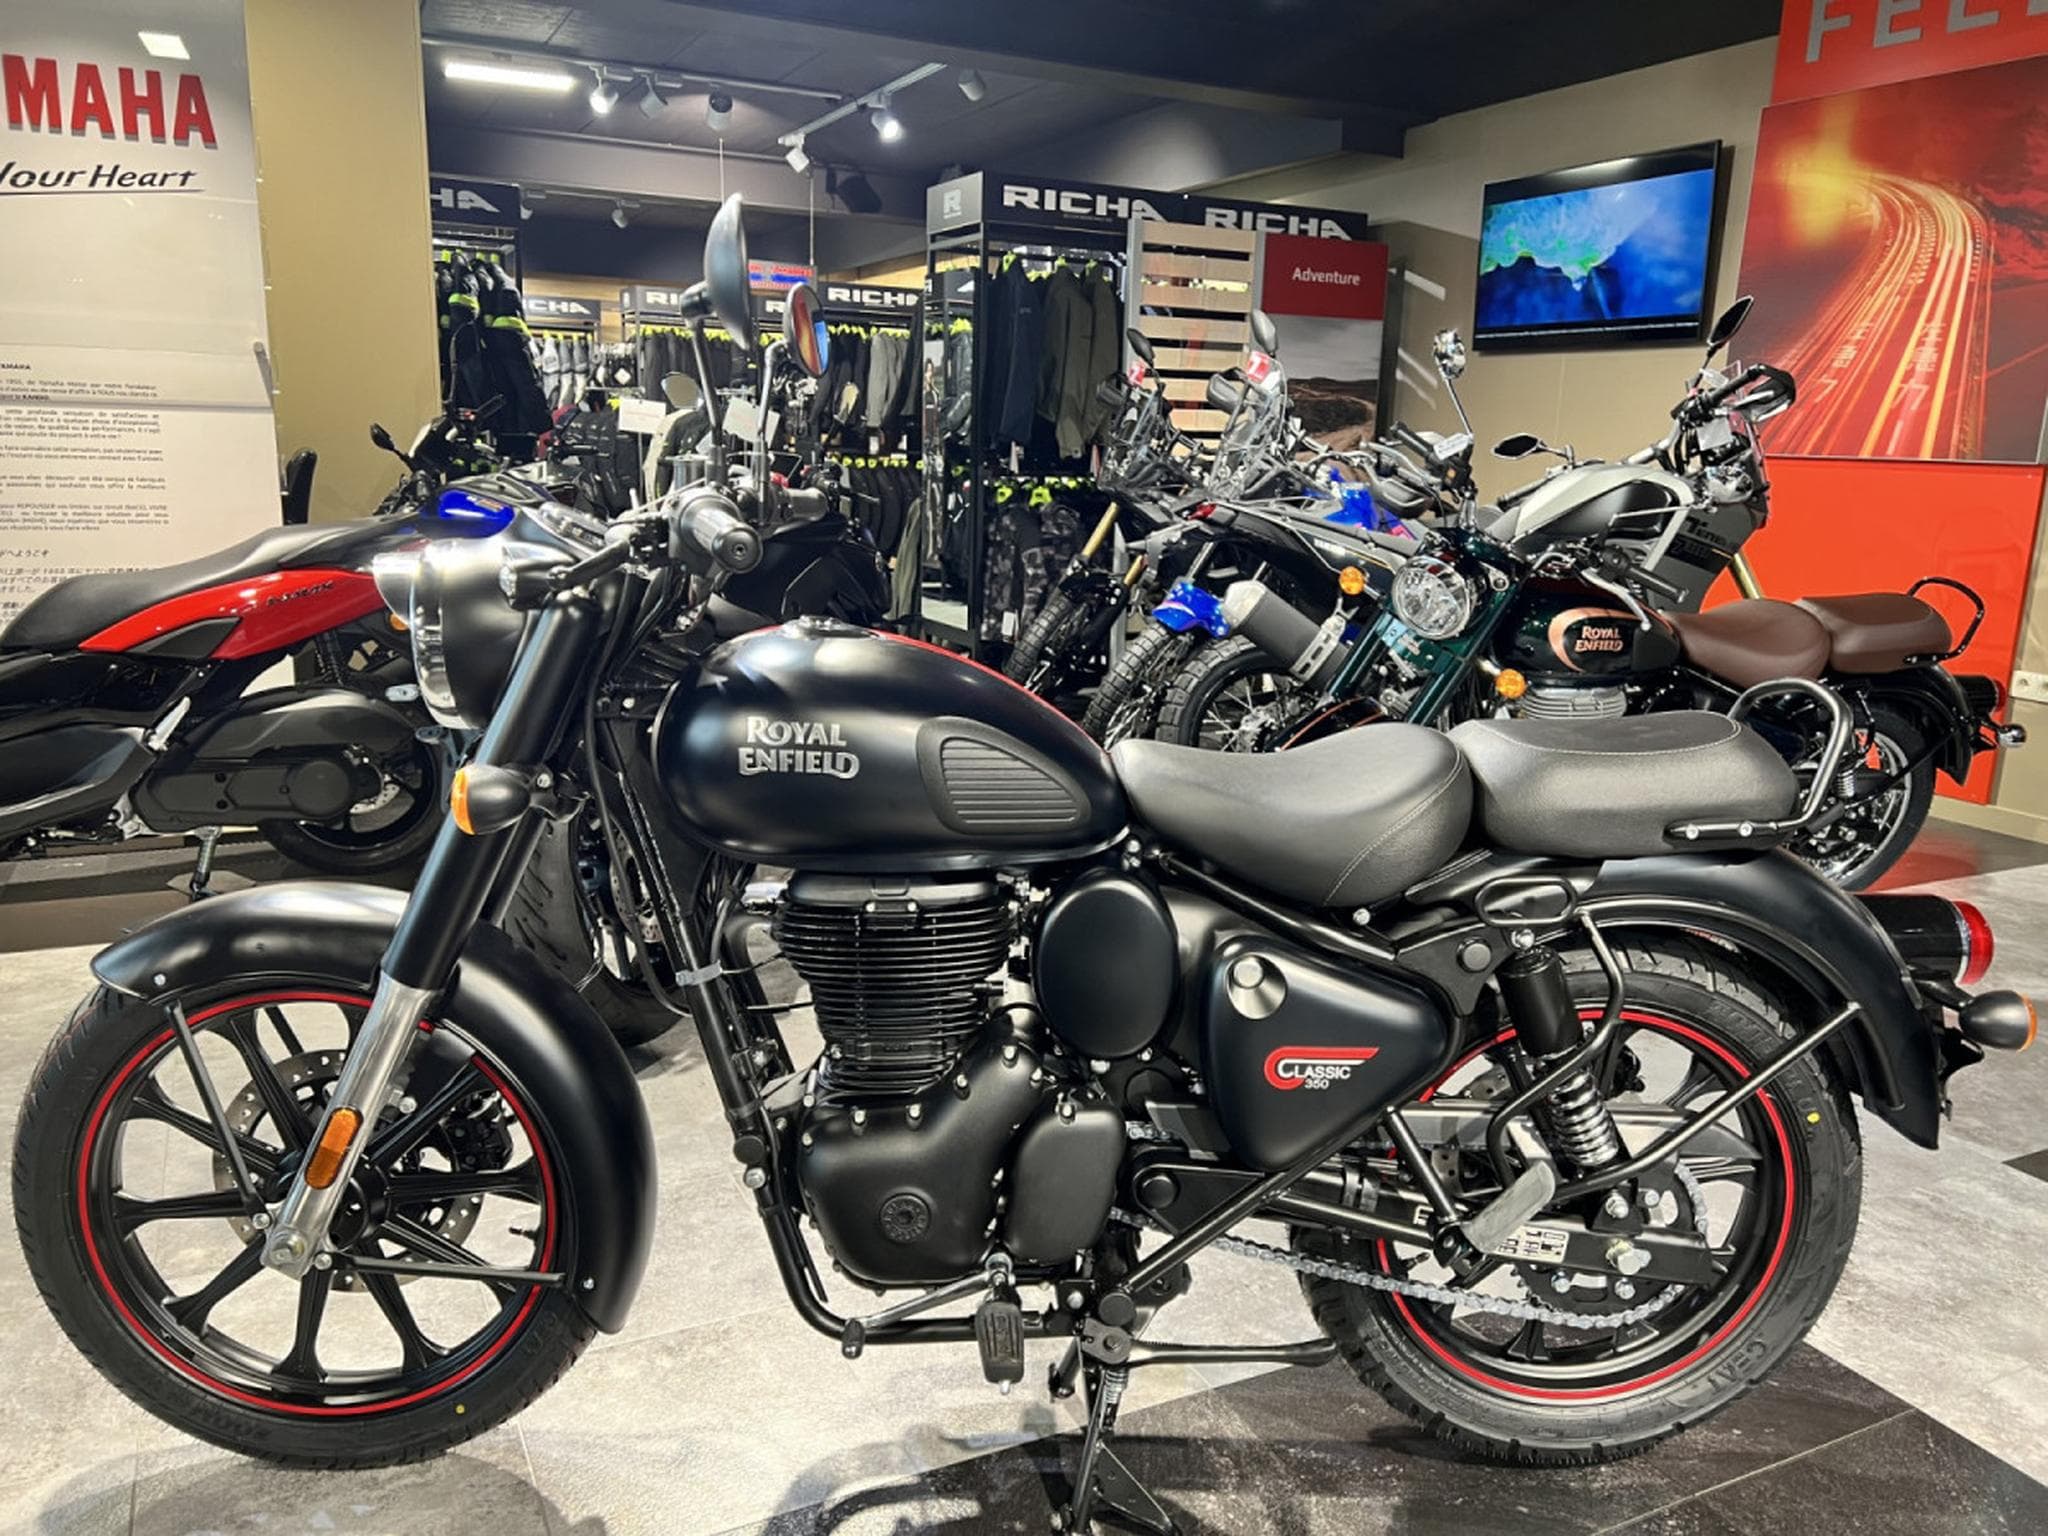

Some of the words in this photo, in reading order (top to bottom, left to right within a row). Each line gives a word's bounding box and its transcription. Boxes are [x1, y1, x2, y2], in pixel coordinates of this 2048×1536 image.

[88, 164, 197, 188] Heart
[1004, 185, 1169, 222] RICHA
[1205, 207, 1352, 241] RICHA
[1292, 267, 1361, 286] Adventure
[1582, 625, 1621, 640] ROYAL
[1574, 639, 1624, 653] ENFIELD
[747, 715, 847, 747] ROYAL
[737, 746, 860, 780] ENFIELD
[1277, 1058, 1353, 1080] CLASSIC
[1304, 1078, 1330, 1090] 350
